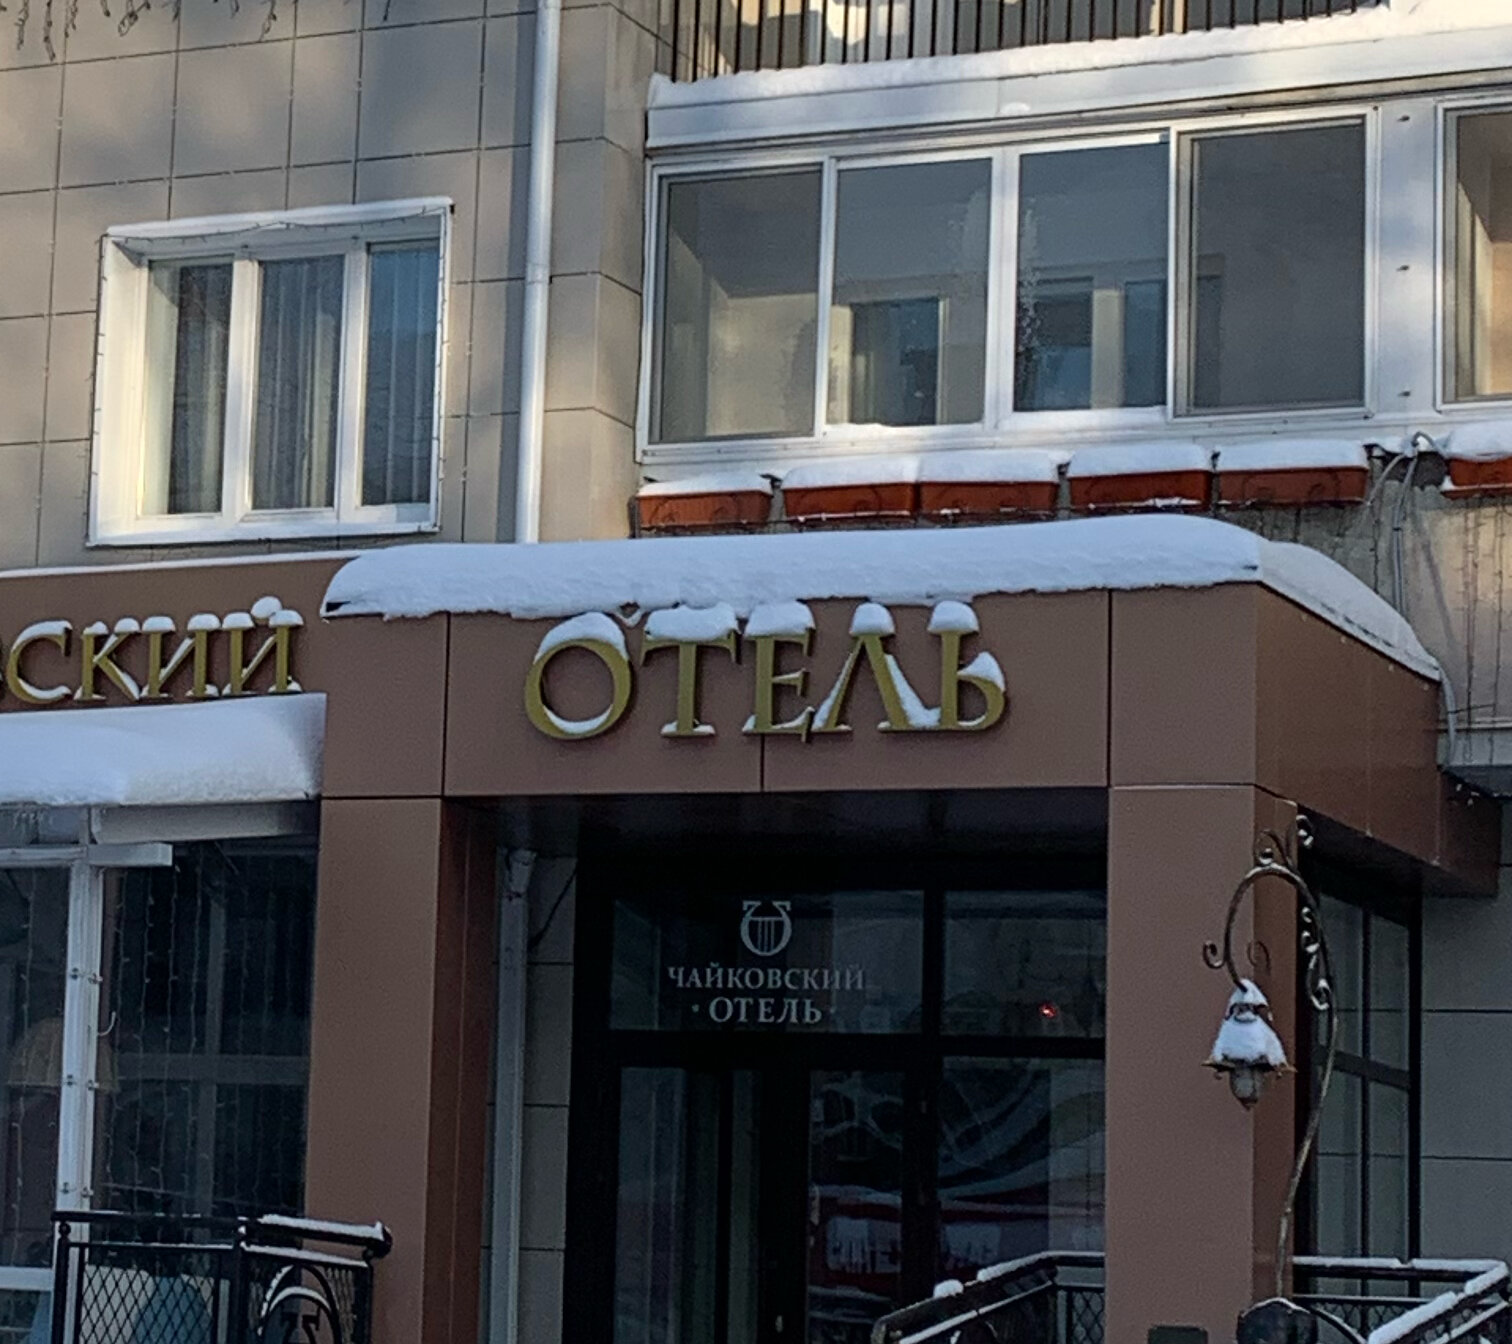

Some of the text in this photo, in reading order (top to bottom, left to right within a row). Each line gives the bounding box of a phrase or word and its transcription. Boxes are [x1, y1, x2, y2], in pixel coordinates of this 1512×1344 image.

[524, 606, 1008, 741] ОТЕЛЬ
[667, 961, 865, 990] ЧАЙКОВСКИЙ
[708, 996, 824, 1024] ОТЕЛЬ
